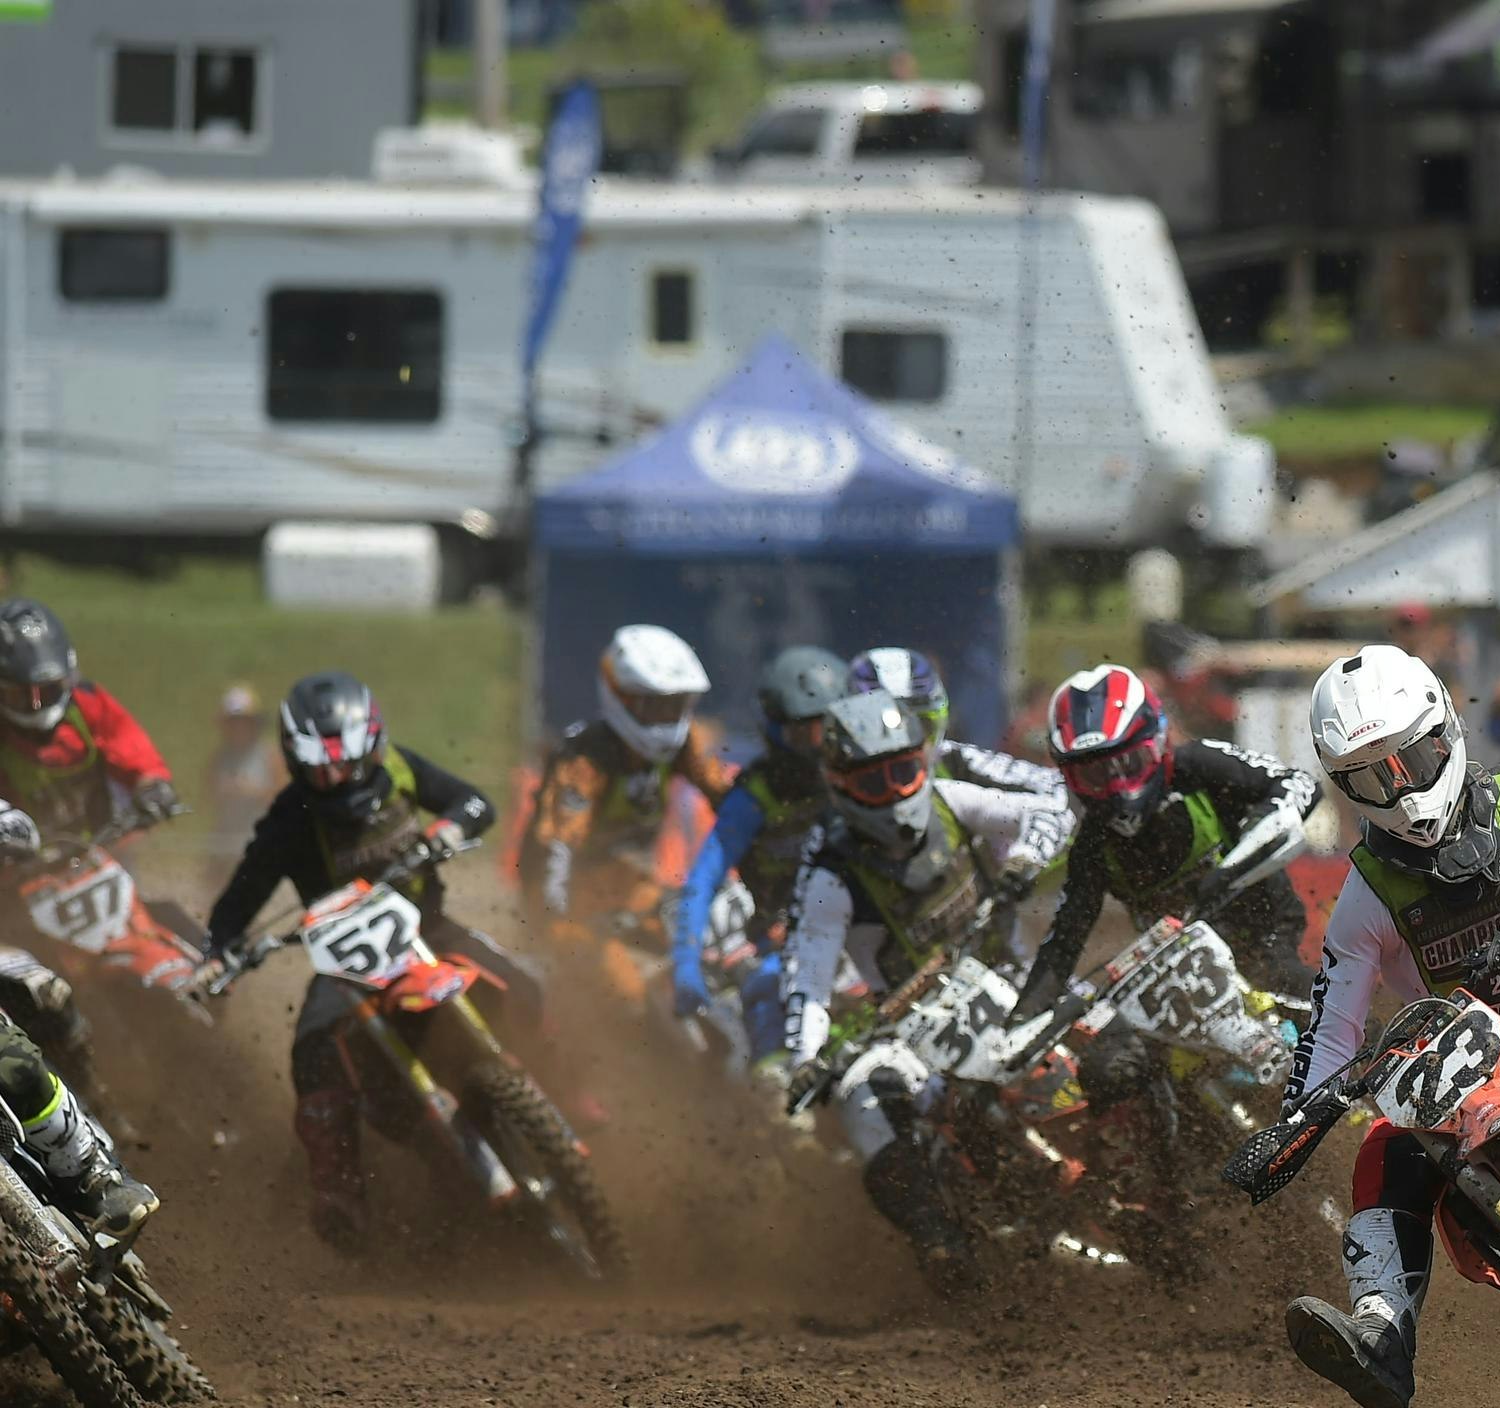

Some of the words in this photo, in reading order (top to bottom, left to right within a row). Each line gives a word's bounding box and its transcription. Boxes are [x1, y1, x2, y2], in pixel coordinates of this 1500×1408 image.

[1352, 722, 1380, 738] BELL
[56, 873, 120, 936] 97
[326, 910, 412, 976] 52
[933, 991, 1012, 1069] 34
[1385, 1054, 1400, 1073] 2020
